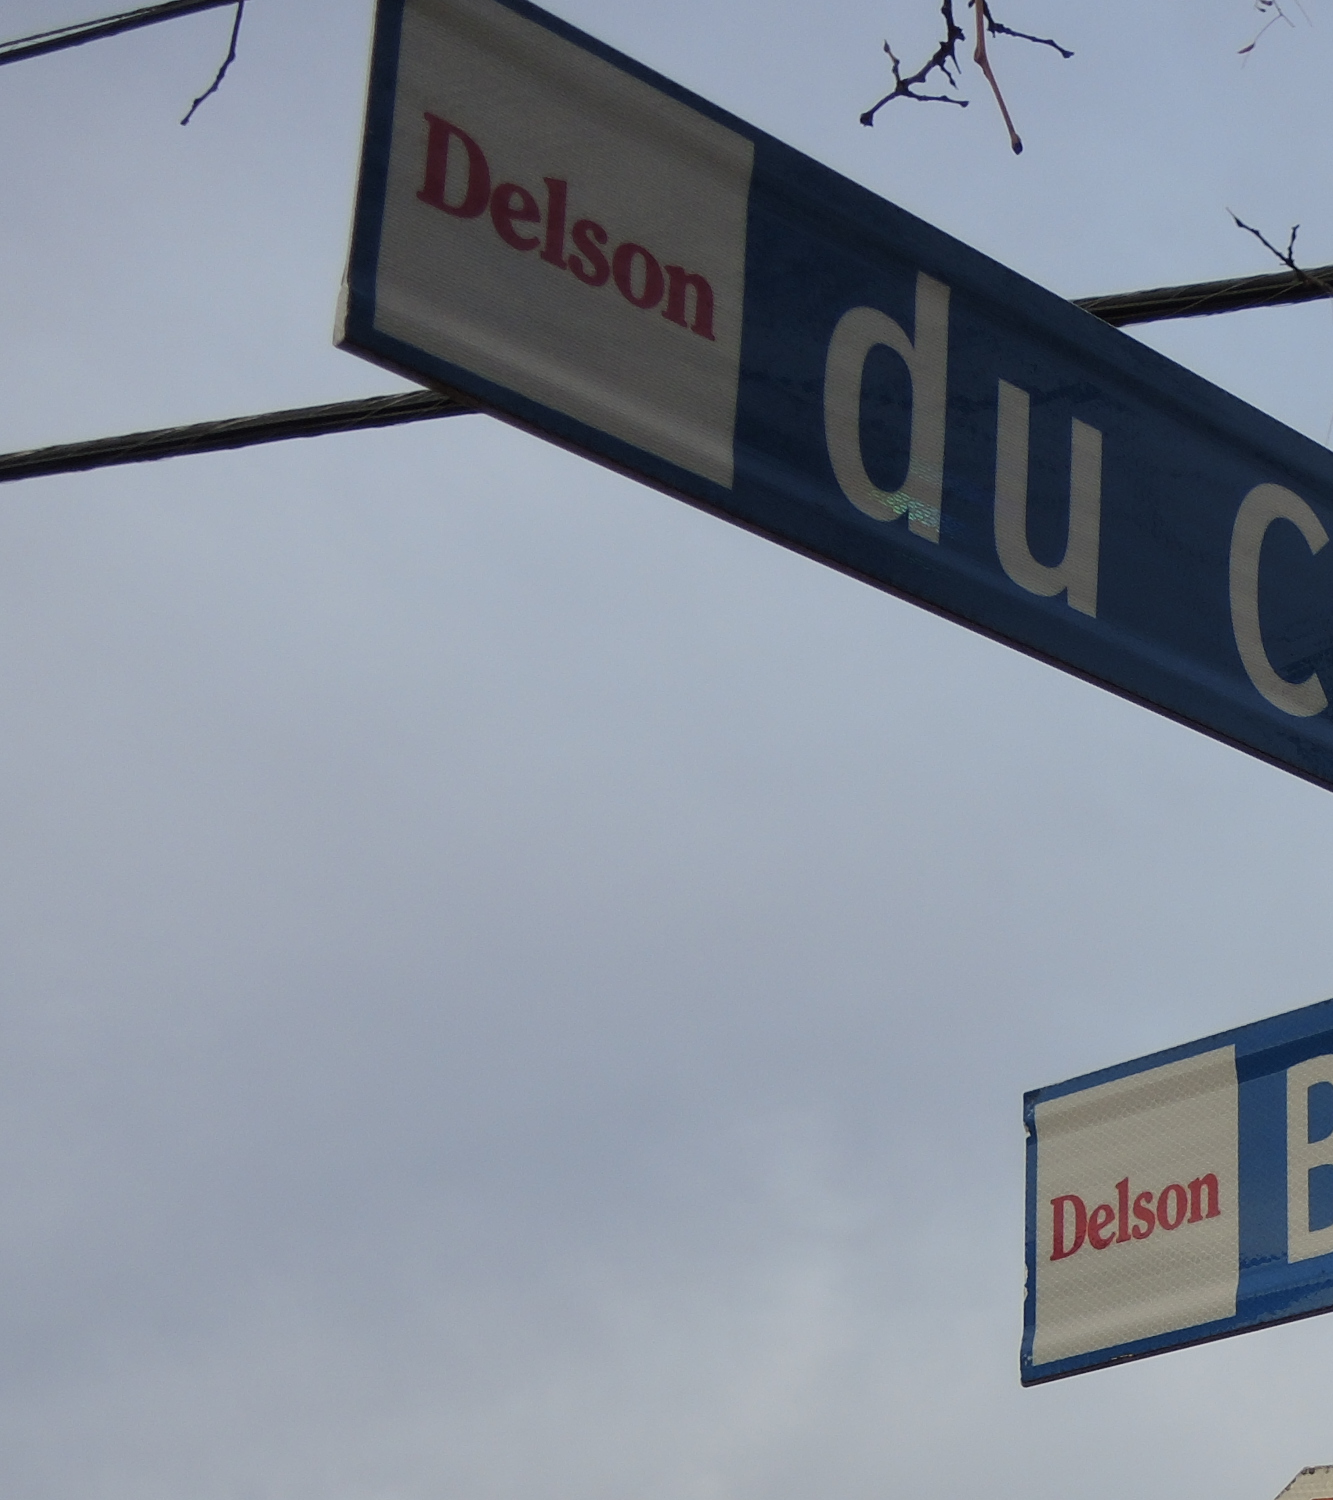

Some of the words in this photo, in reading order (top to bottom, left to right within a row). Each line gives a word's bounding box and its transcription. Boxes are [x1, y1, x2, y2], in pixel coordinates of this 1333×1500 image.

[415, 112, 717, 342] Delson
[823, 270, 1103, 618] du
[1050, 1171, 1221, 1262] Delson
